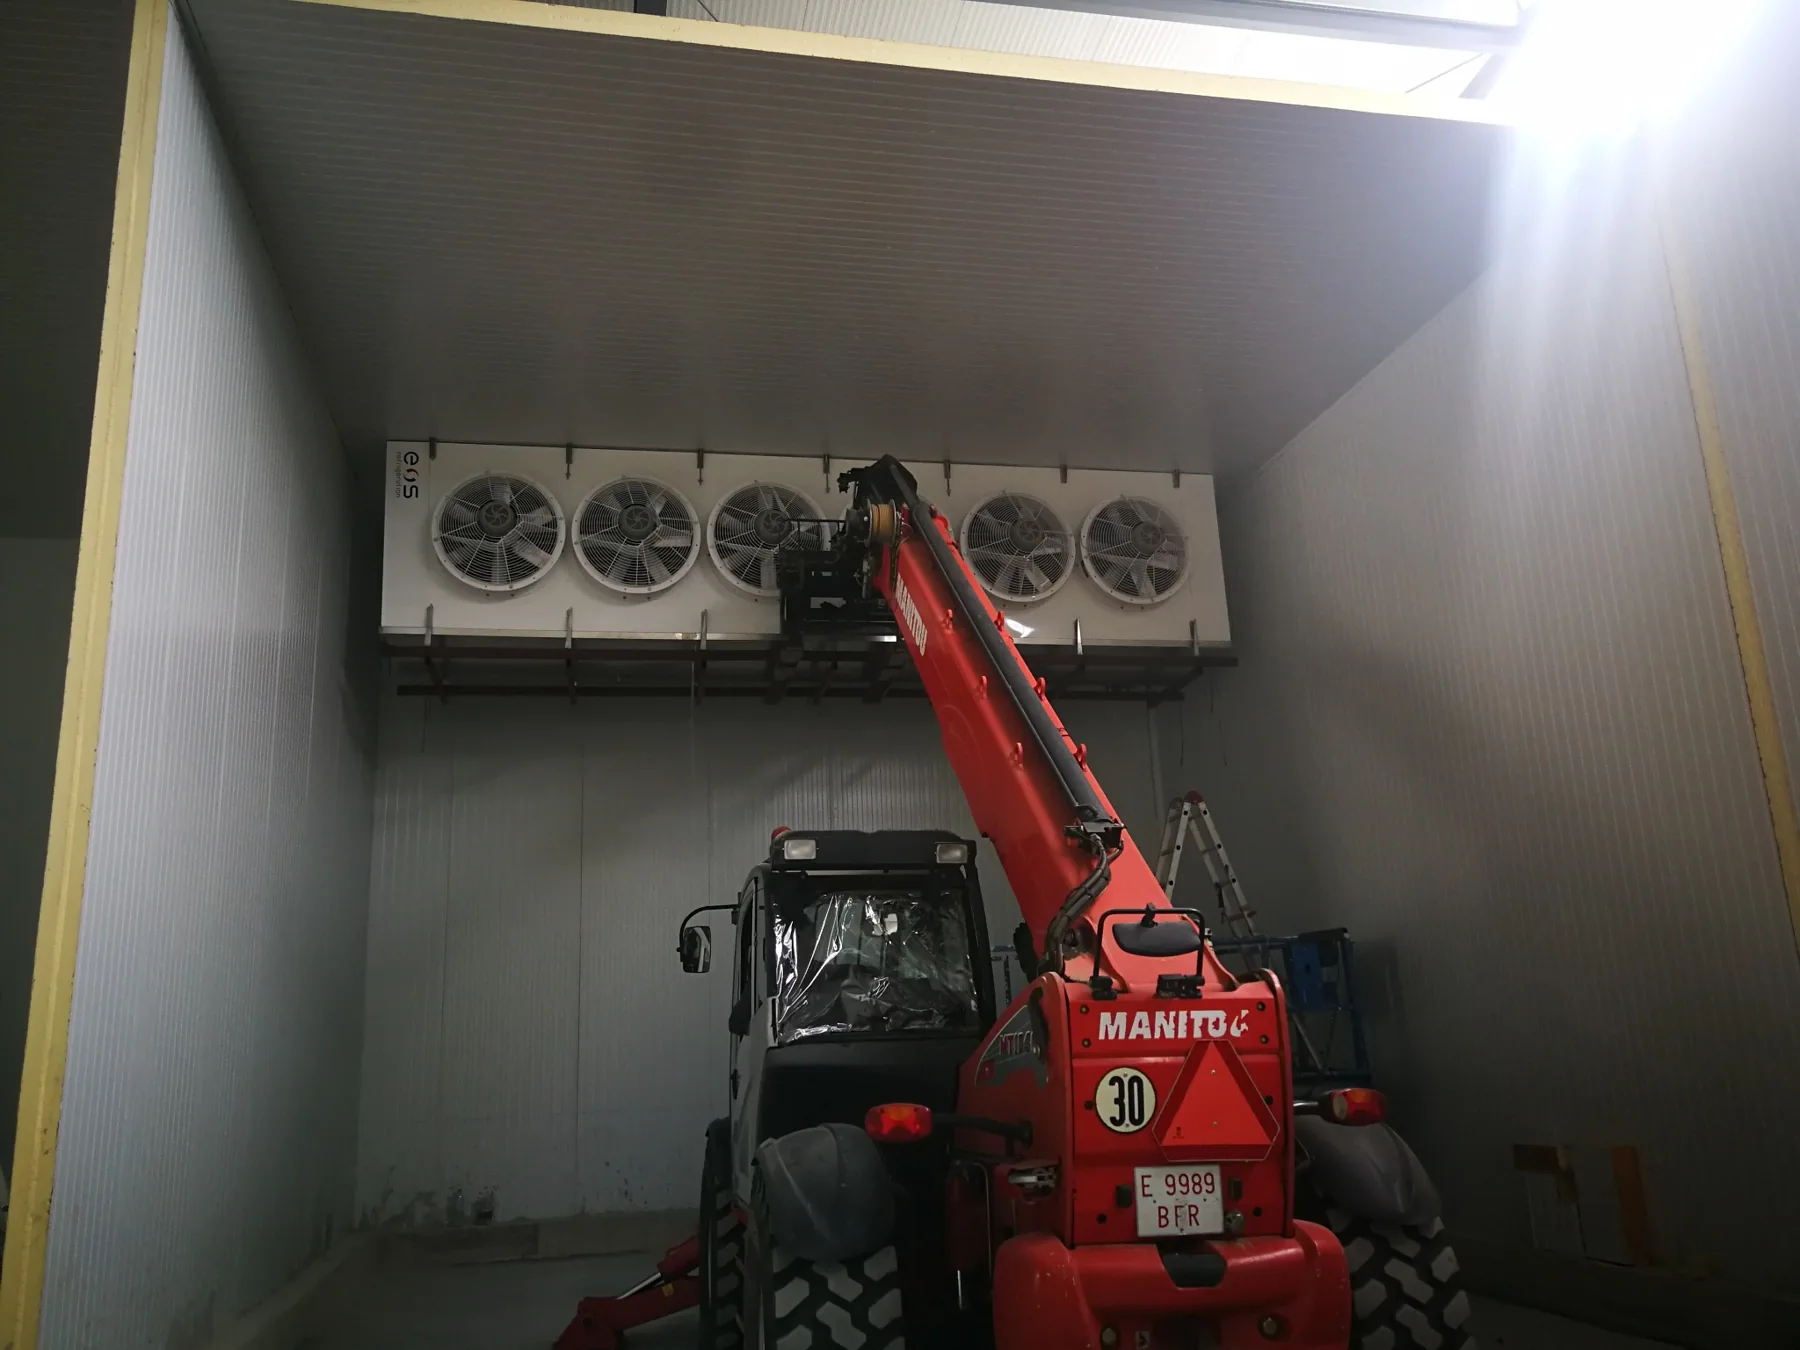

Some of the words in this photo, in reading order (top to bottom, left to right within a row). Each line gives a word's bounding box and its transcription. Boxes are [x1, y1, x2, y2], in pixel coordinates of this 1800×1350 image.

[403, 451, 419, 499] eos
[895, 572, 928, 657] MANITOU
[1108, 1075, 1145, 1127] 30
[1141, 1174, 1153, 1197] E
[1165, 1172, 1215, 1196] 9989
[1158, 1204, 1200, 1228] BFR
